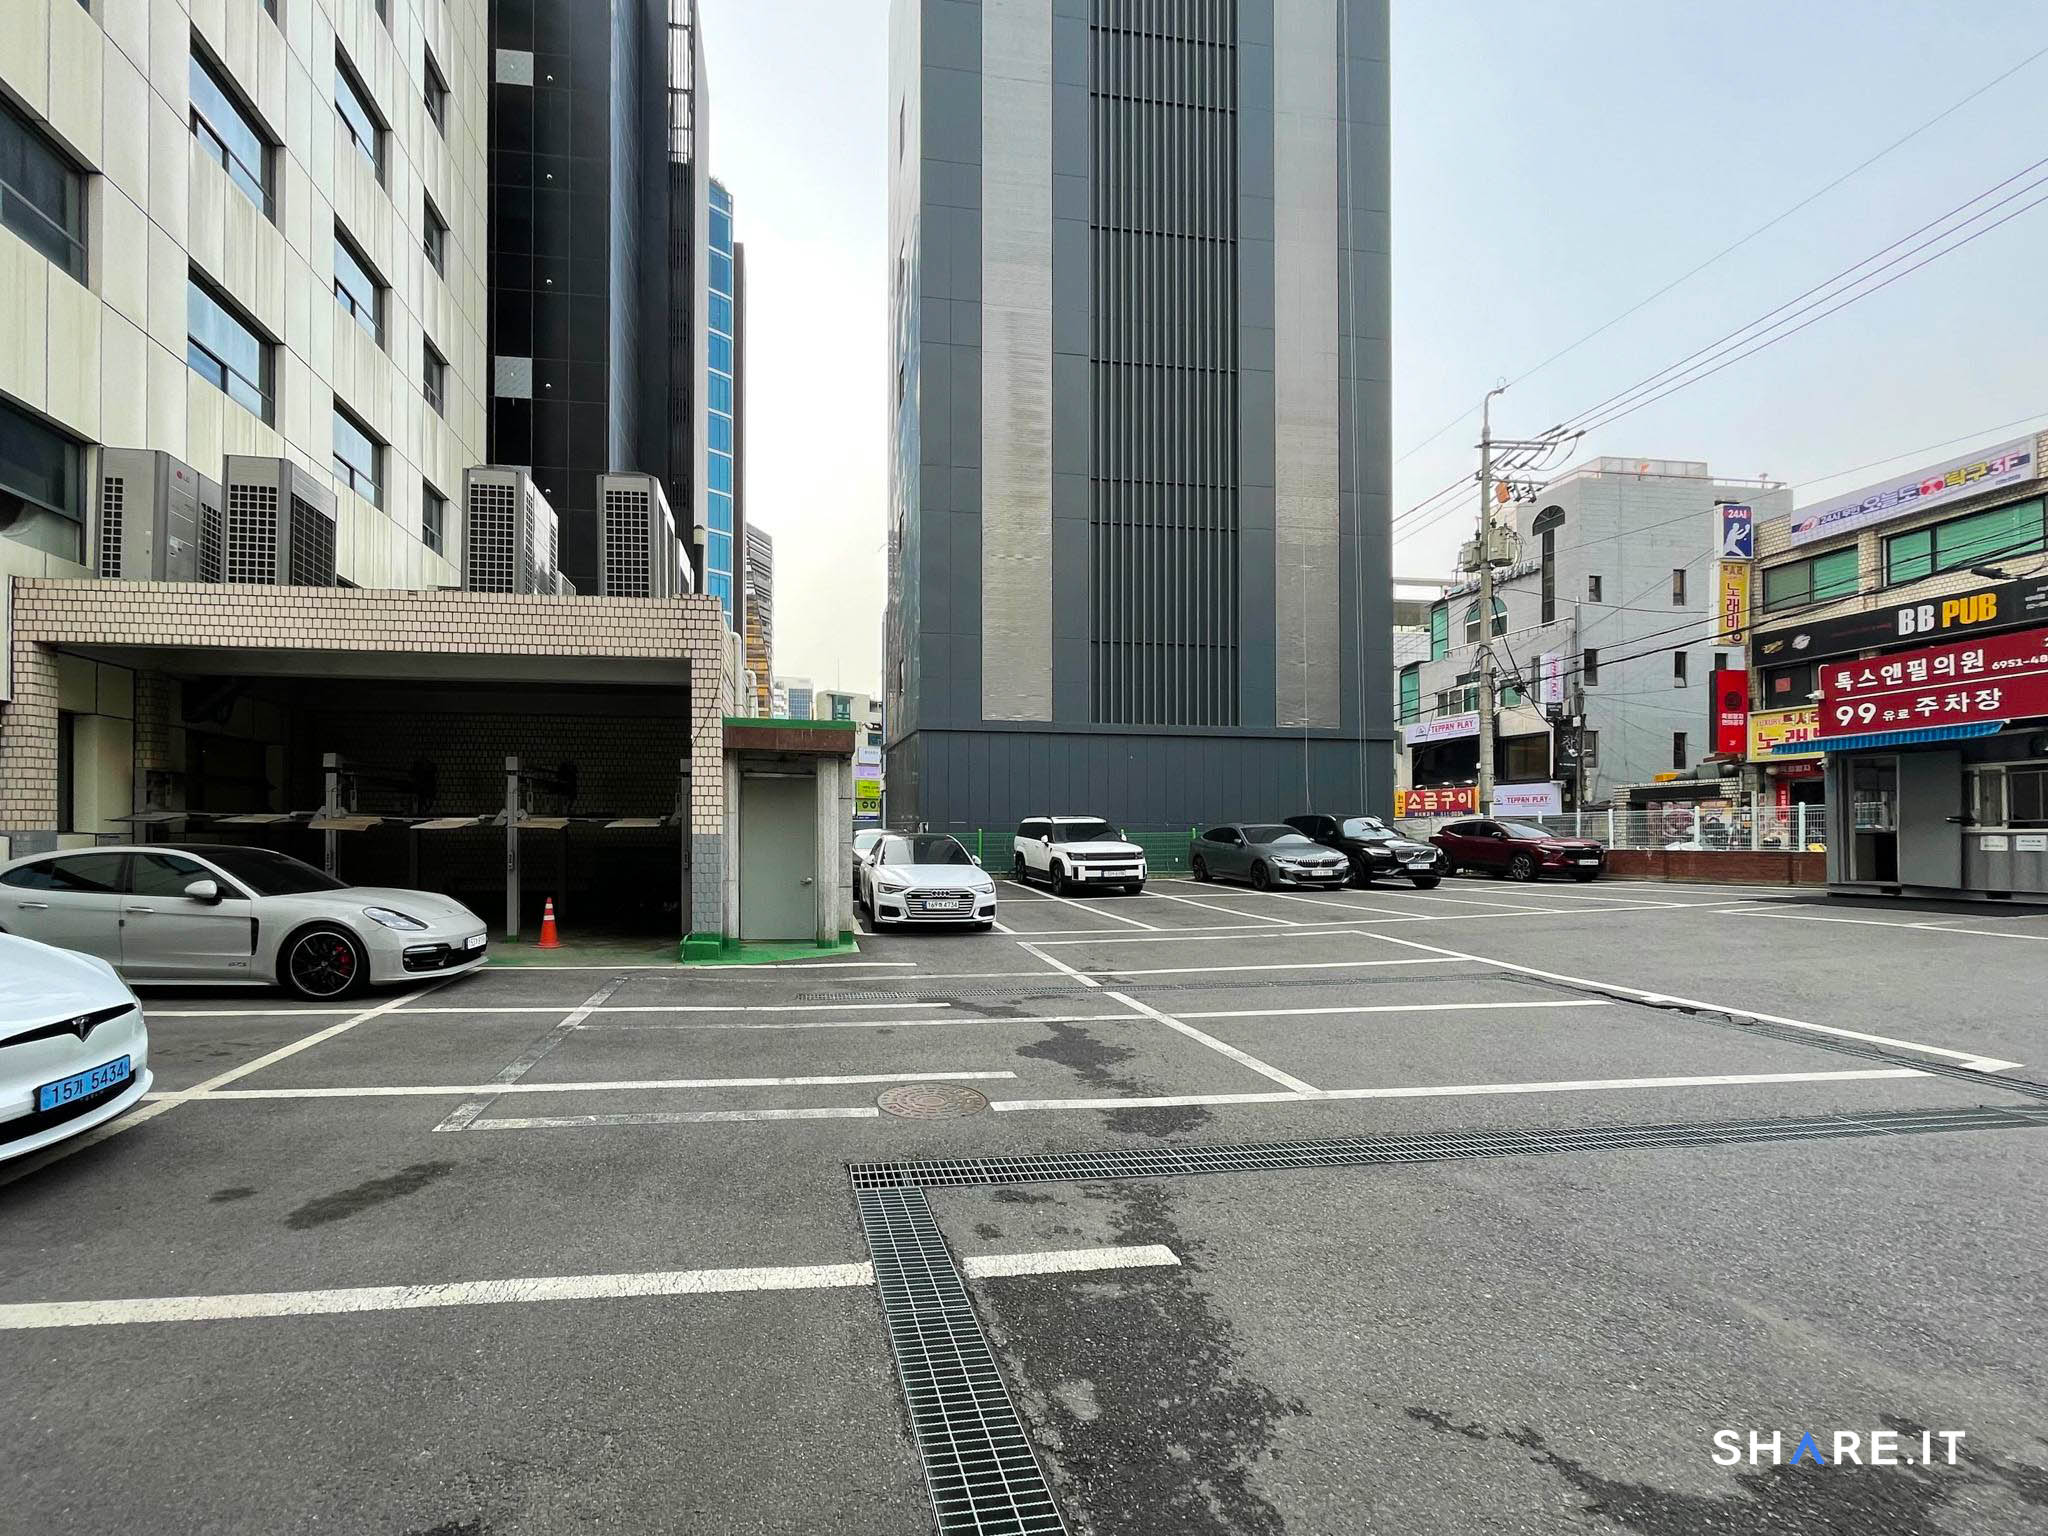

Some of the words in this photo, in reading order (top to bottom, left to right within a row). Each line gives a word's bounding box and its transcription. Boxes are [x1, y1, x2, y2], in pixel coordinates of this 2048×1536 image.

[1989, 451, 2020, 475] 3F
[1726, 582, 1742, 643] 노래방
[1898, 604, 1935, 636] BB
[1942, 592, 1997, 628] PUB
[1834, 649, 1985, 692] 톡스앤필의원
[1835, 702, 1877, 727] 99
[1882, 709, 1911, 722] 유료
[1914, 687, 2003, 717] 주차장
[1431, 722, 1455, 733] TEPPAN
[1457, 720, 1474, 730] PLAY
[1407, 789, 1473, 811] 소금구이
[1532, 795, 1548, 803] PLAY
[91, 1061, 124, 1090] 5434
